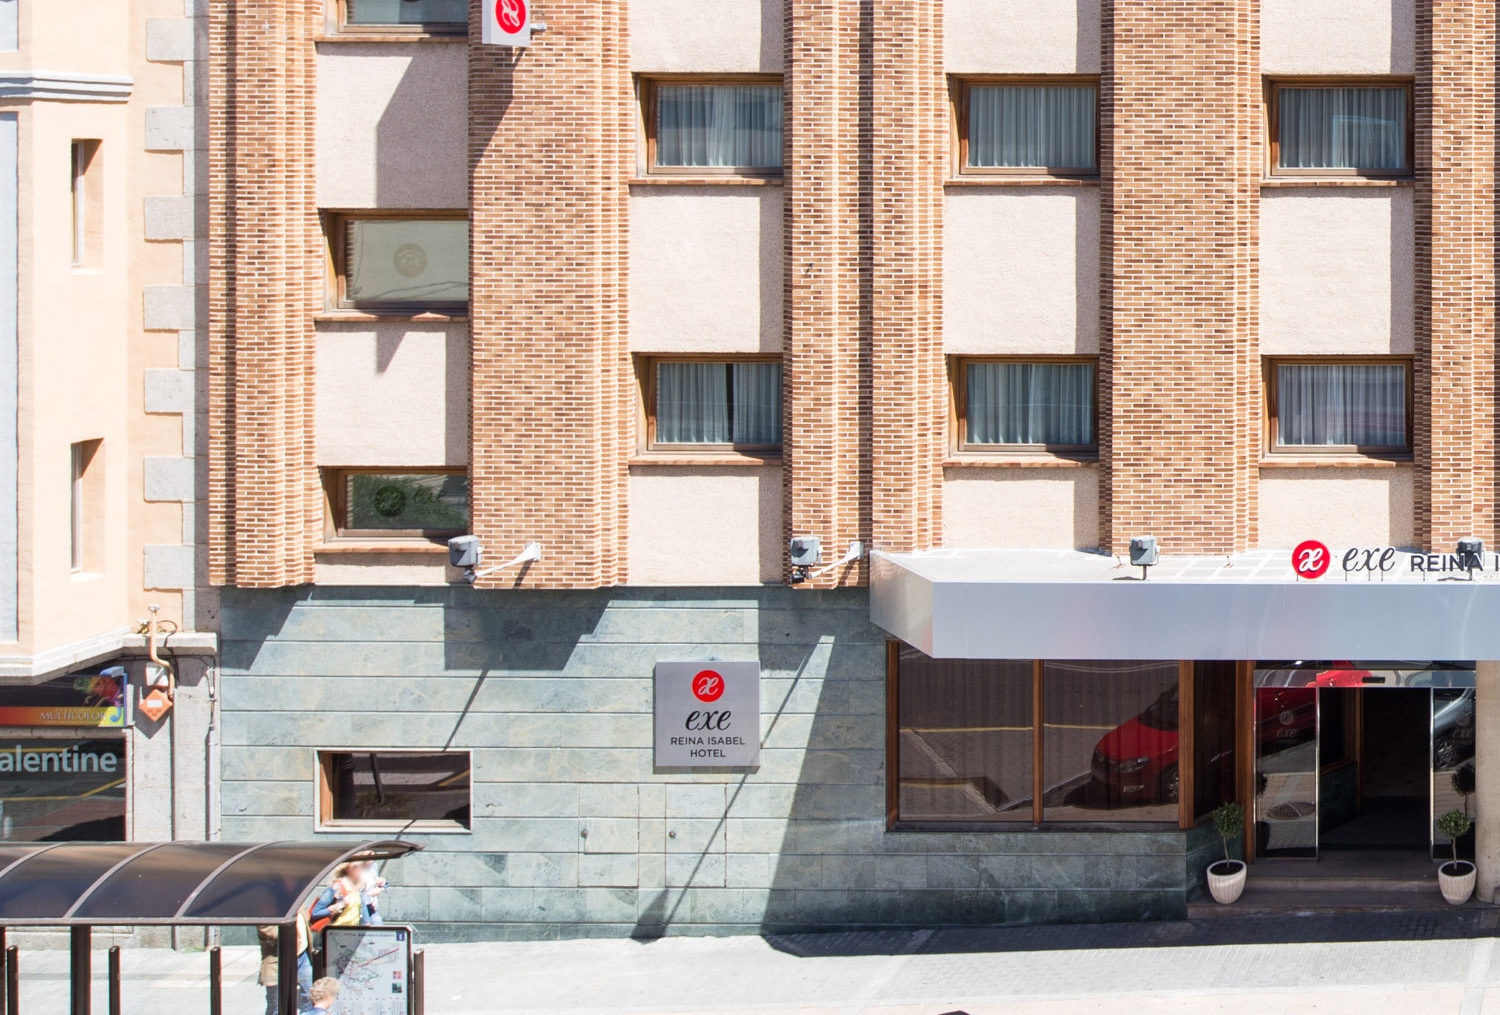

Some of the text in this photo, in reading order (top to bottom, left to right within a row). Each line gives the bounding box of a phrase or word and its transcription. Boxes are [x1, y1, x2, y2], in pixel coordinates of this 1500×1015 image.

[1342, 546, 1396, 573] exe
[1410, 553, 1484, 573] REINA
[40, 712, 107, 721] MULTICOLOR
[685, 710, 732, 731] exe
[670, 737, 746, 746] REINA ISABEL
[690, 749, 726, 758] HOTEL
